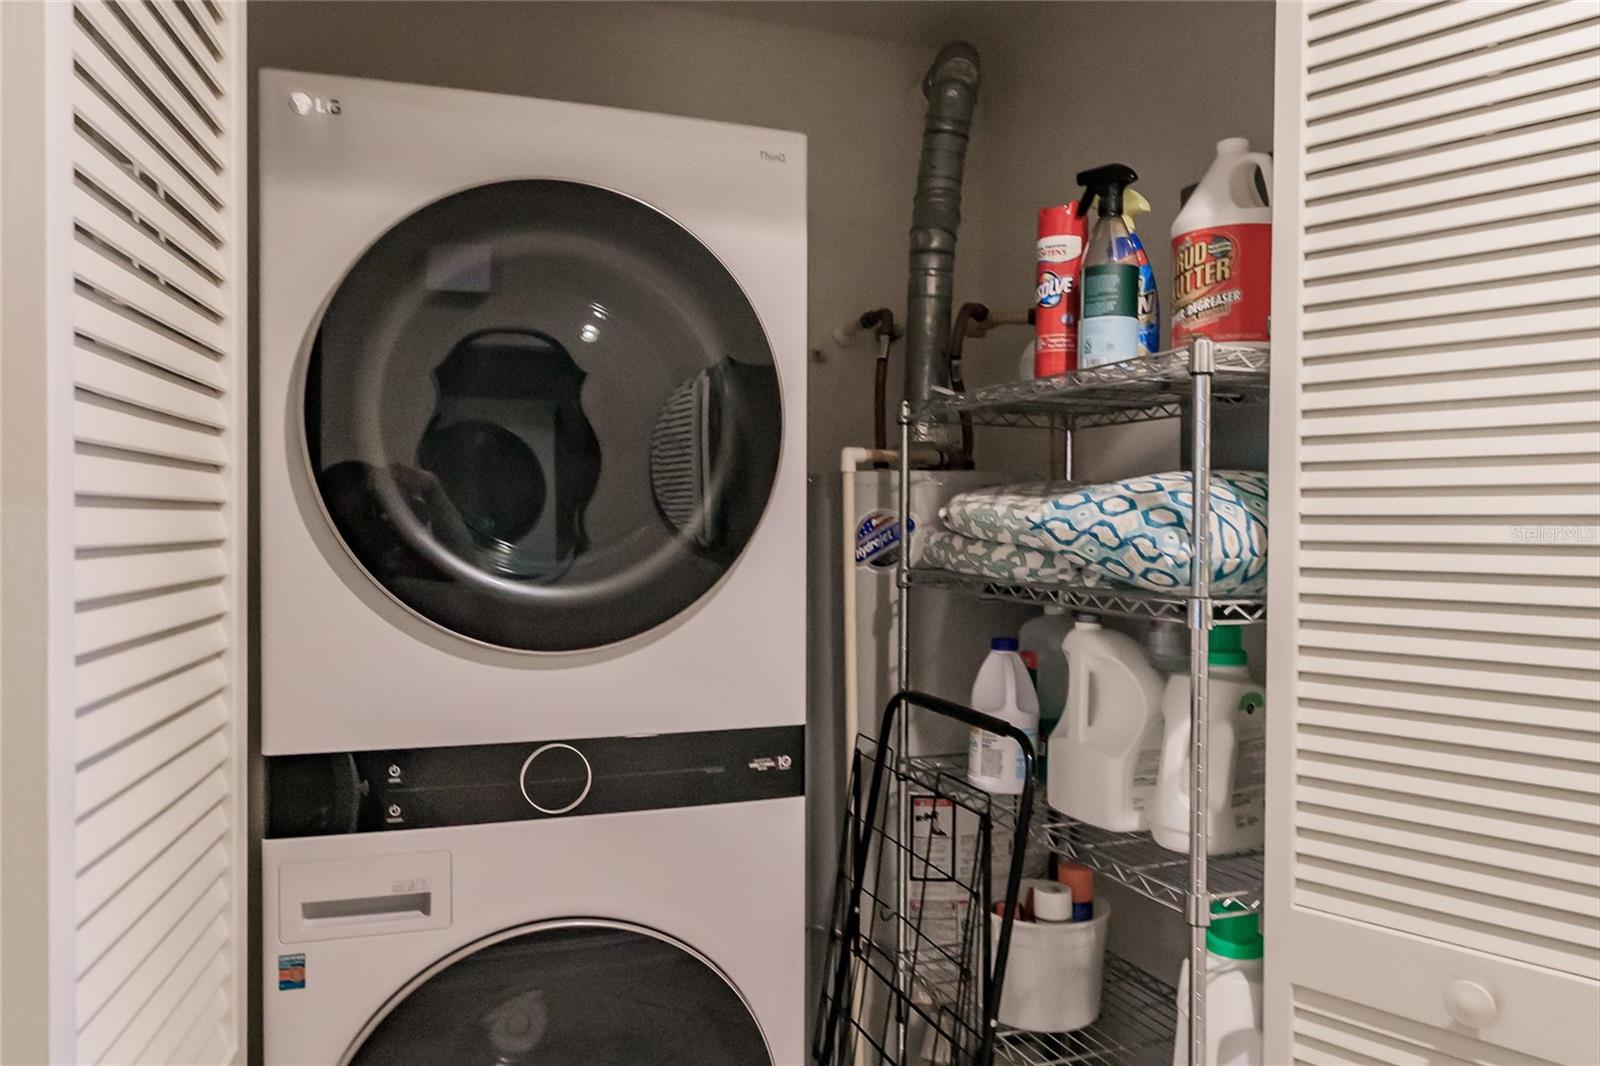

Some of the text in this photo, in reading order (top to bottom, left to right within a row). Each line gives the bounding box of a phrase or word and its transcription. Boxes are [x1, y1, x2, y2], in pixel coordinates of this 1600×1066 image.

[315, 97, 341, 115] LG
[1176, 241, 1207, 275] RUD
[1036, 276, 1074, 302] SOLVE
[1173, 258, 1231, 302] UTTER
